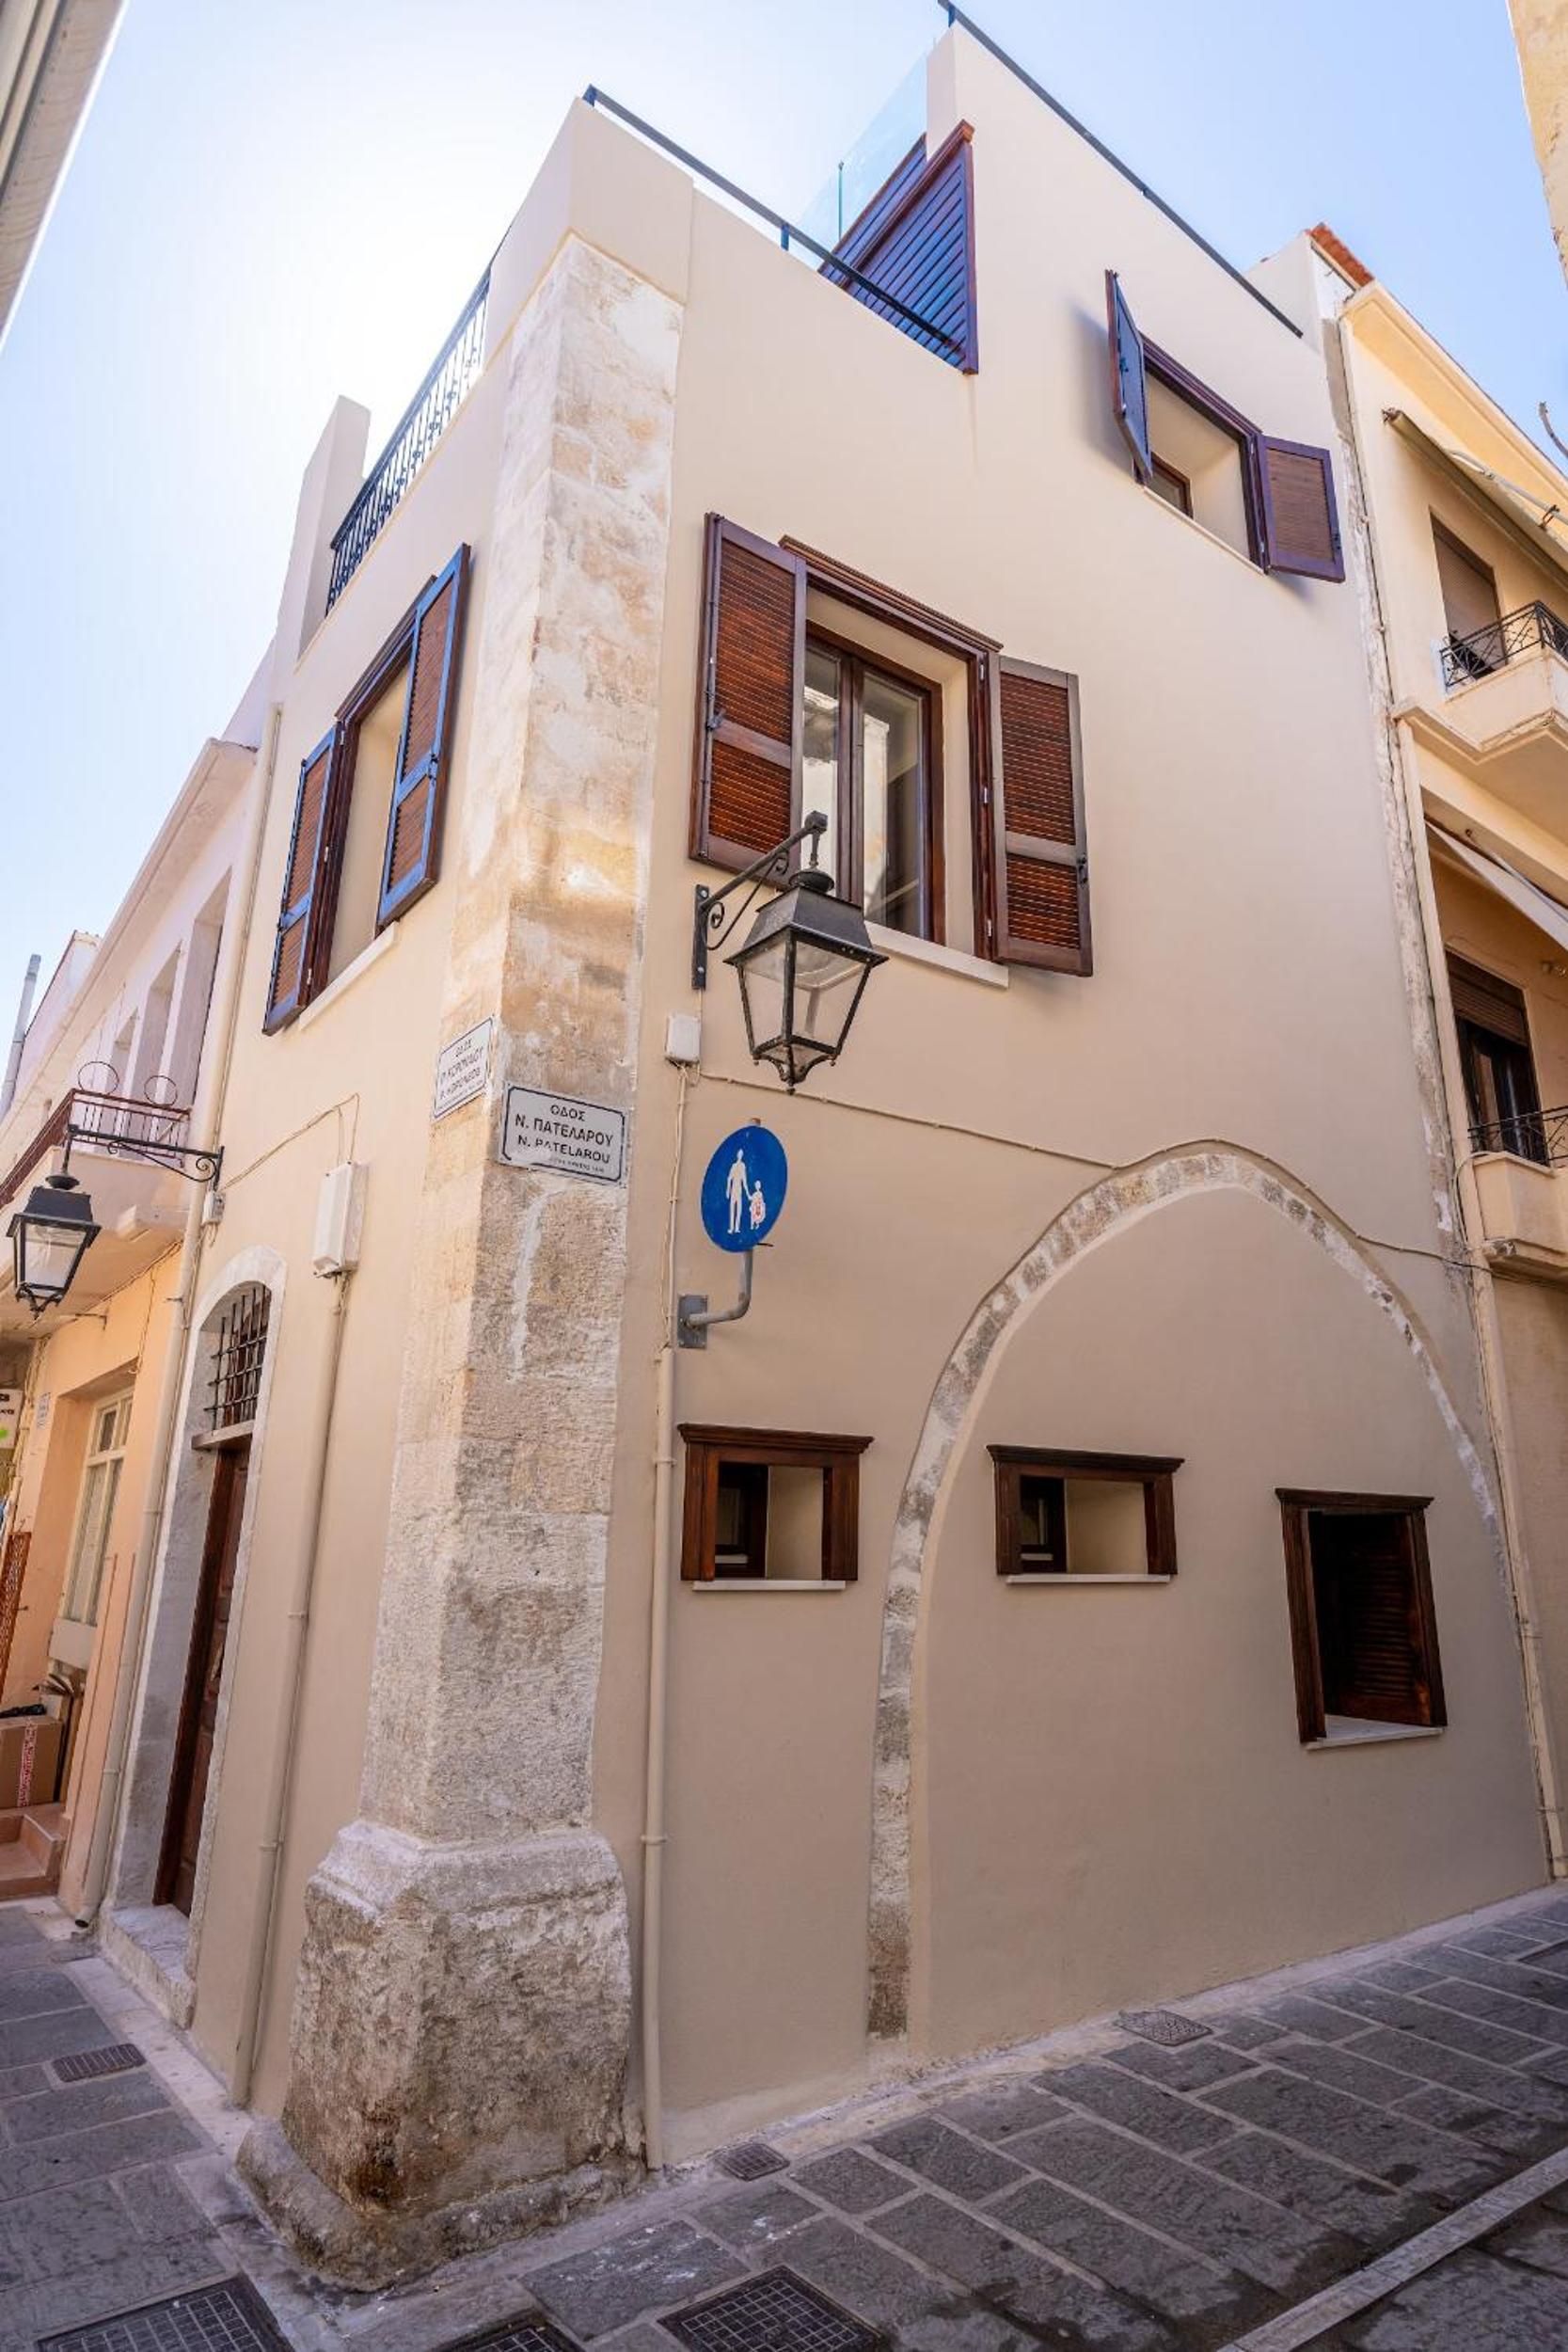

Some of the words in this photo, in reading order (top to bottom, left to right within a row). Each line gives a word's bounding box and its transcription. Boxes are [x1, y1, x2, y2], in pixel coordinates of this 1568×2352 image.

[550, 1104, 585, 1121] ΟΔΟΣ
[515, 1114, 529, 1129] Ν.
[533, 1118, 614, 1146] ΠΑΤΕΛΑΡΟΥ
[517, 1135, 531, 1147] N.
[535, 1137, 610, 1164] PATELAROU
